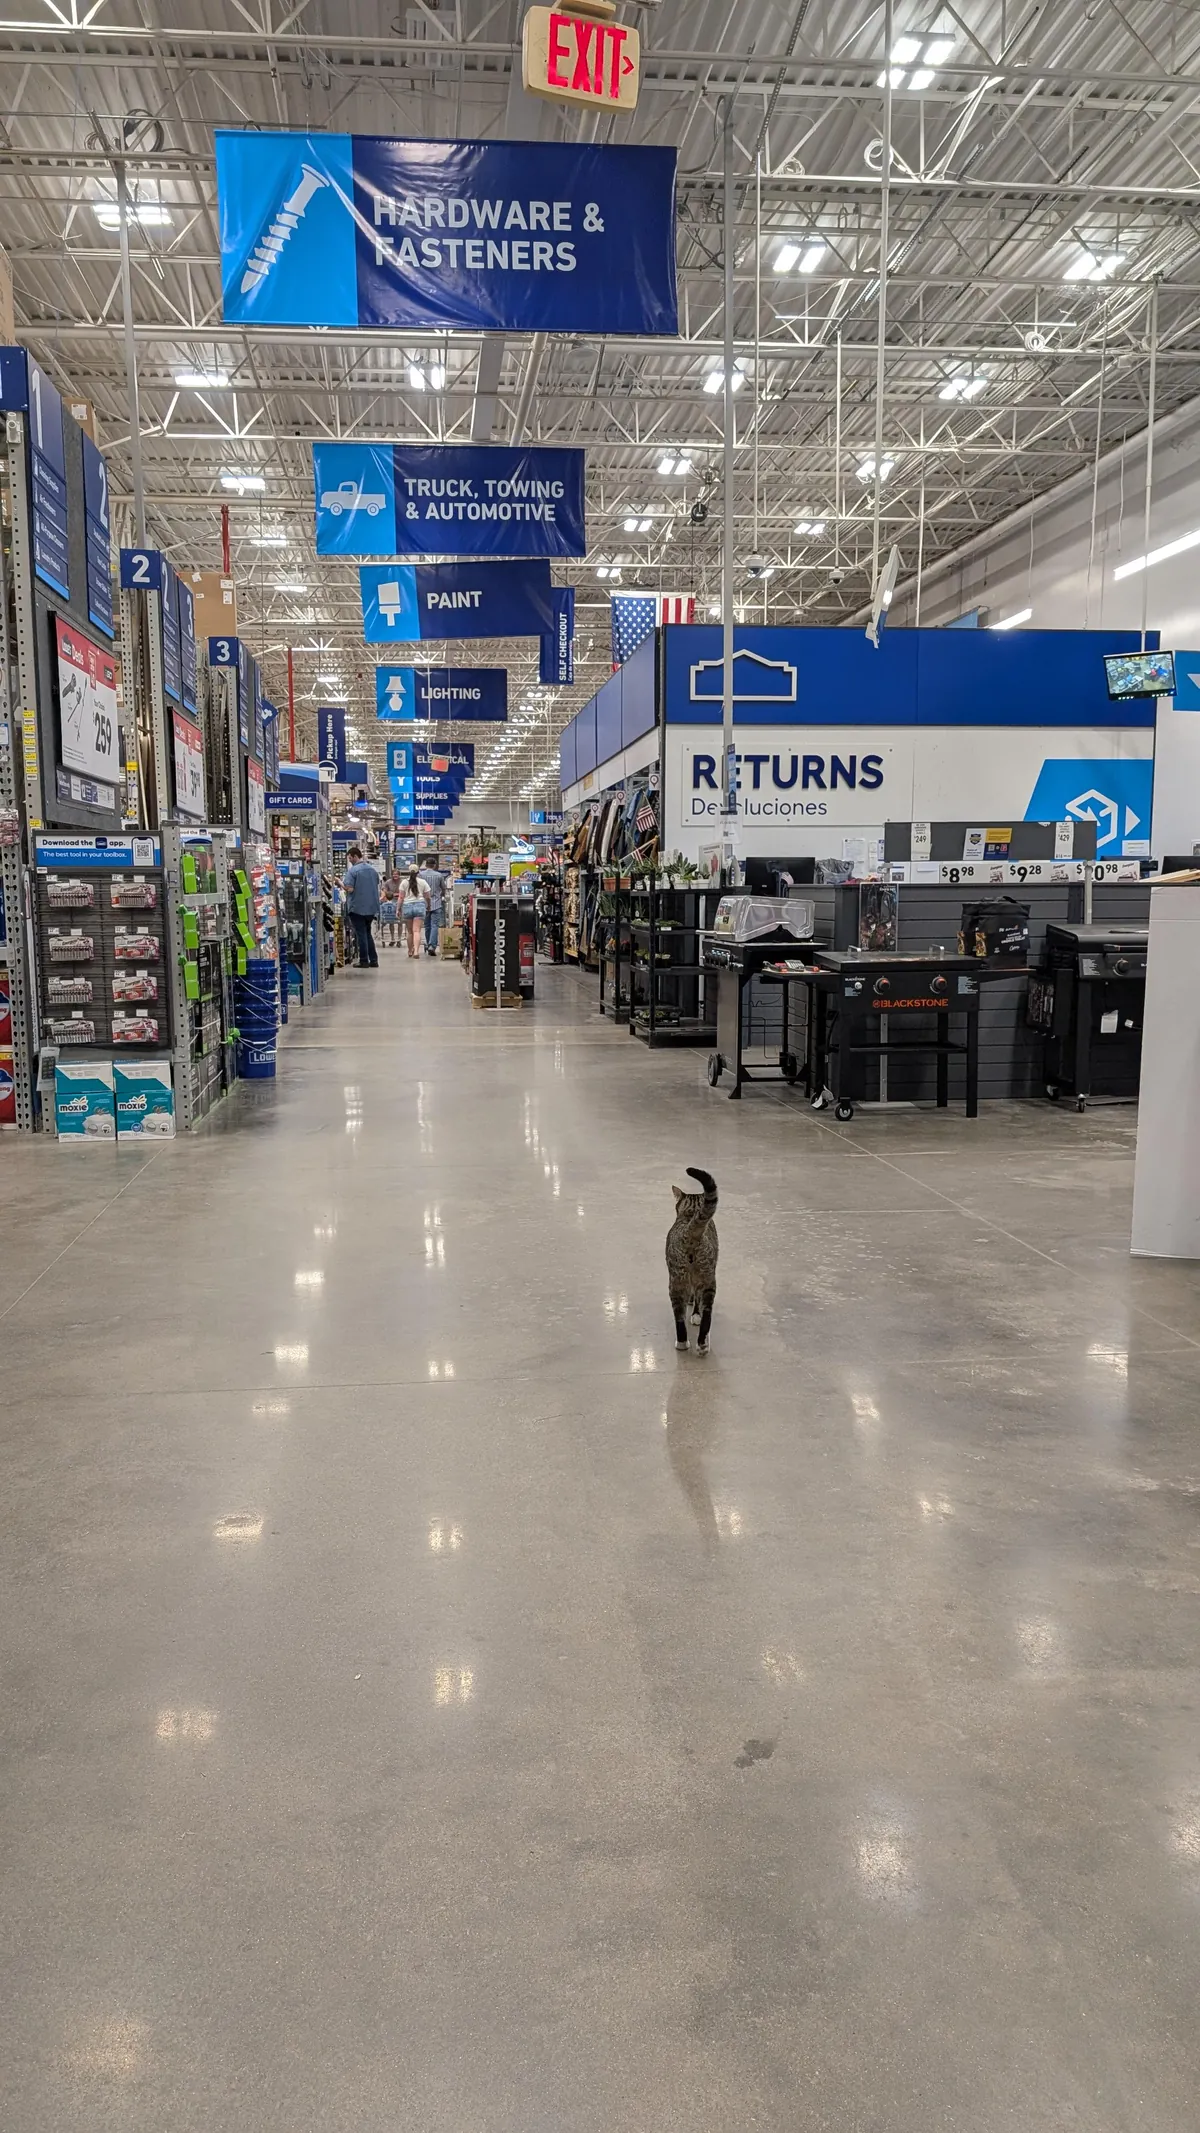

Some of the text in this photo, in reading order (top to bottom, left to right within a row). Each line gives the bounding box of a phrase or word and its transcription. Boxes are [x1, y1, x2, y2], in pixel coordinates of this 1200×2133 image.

[548, 14, 627, 99] EXIT
[373, 196, 605, 233] HARDWARE &
[375, 237, 578, 272] FASTENERS
[31, 368, 43, 450] 1
[404, 478, 565, 499] TRUCK, TOWING
[405, 501, 557, 522] & AUTOMOTIVE
[131, 554, 151, 583] 2
[426, 590, 482, 610] PAINT
[216, 640, 231, 662] 3
[558, 612, 568, 681] SELF CHECKOUT
[421, 685, 482, 702] LIGHTING
[326, 714, 335, 760] Pickup Here
[416, 755, 469, 765] ELEICAL
[691, 798, 828, 816] Deluciones
[880, 999, 949, 1008] BLACKSTONE
[60, 1104, 88, 1112] moxie
[119, 1103, 146, 1111] moxie
